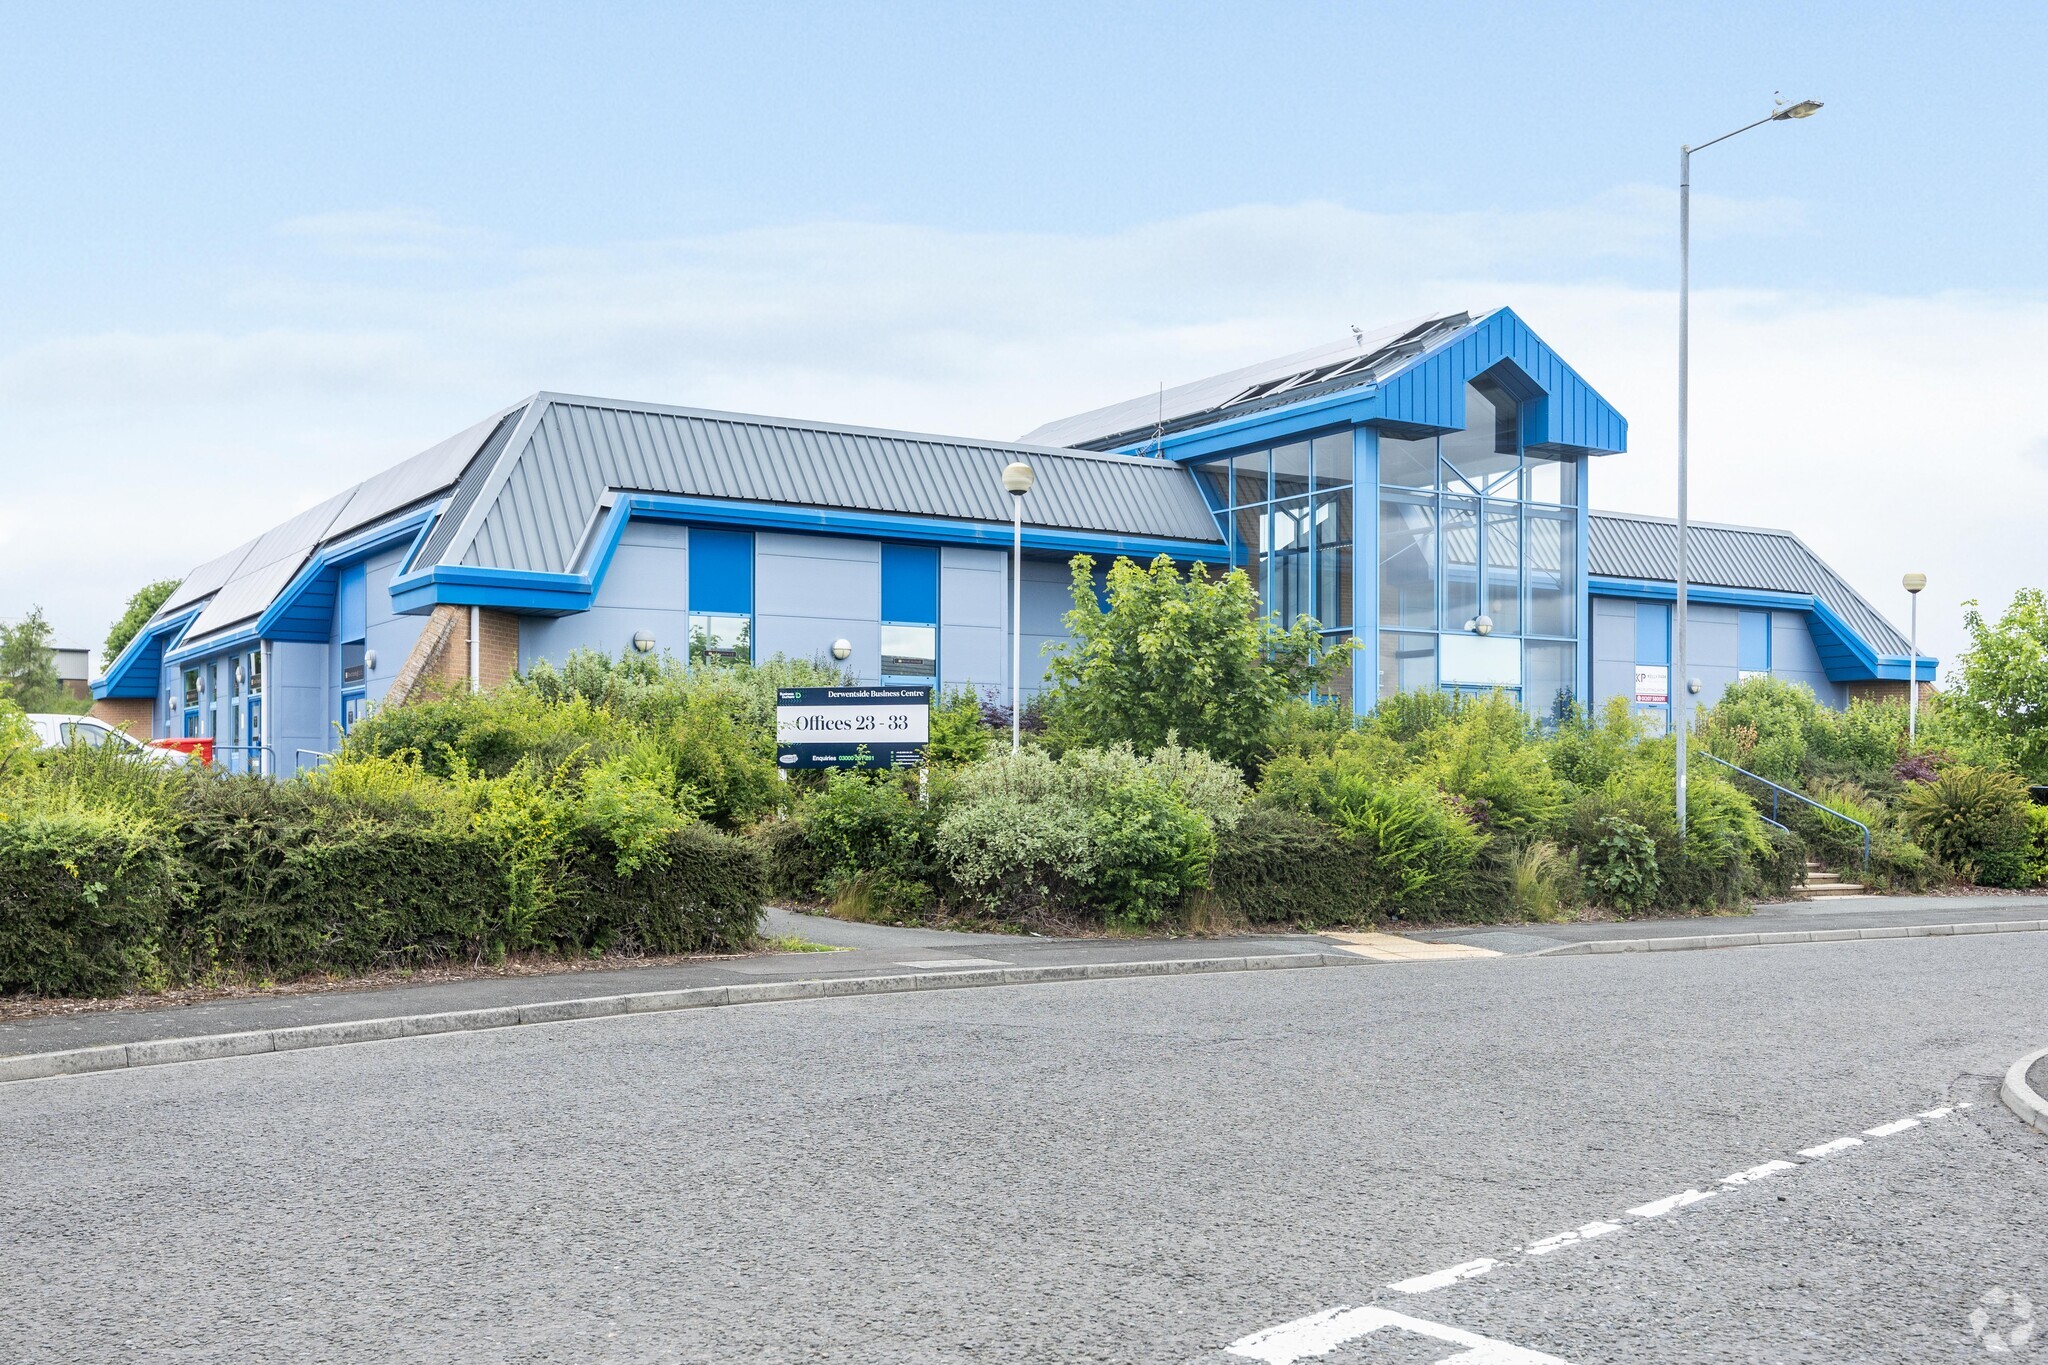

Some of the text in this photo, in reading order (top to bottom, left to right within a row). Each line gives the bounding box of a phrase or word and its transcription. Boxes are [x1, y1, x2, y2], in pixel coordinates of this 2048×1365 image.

[828, 690, 870, 698] Derwentside
[900, 689, 924, 697] Centre
[795, 715, 852, 731] Offices
[855, 715, 875, 731] 23
[888, 715, 908, 731] 33
